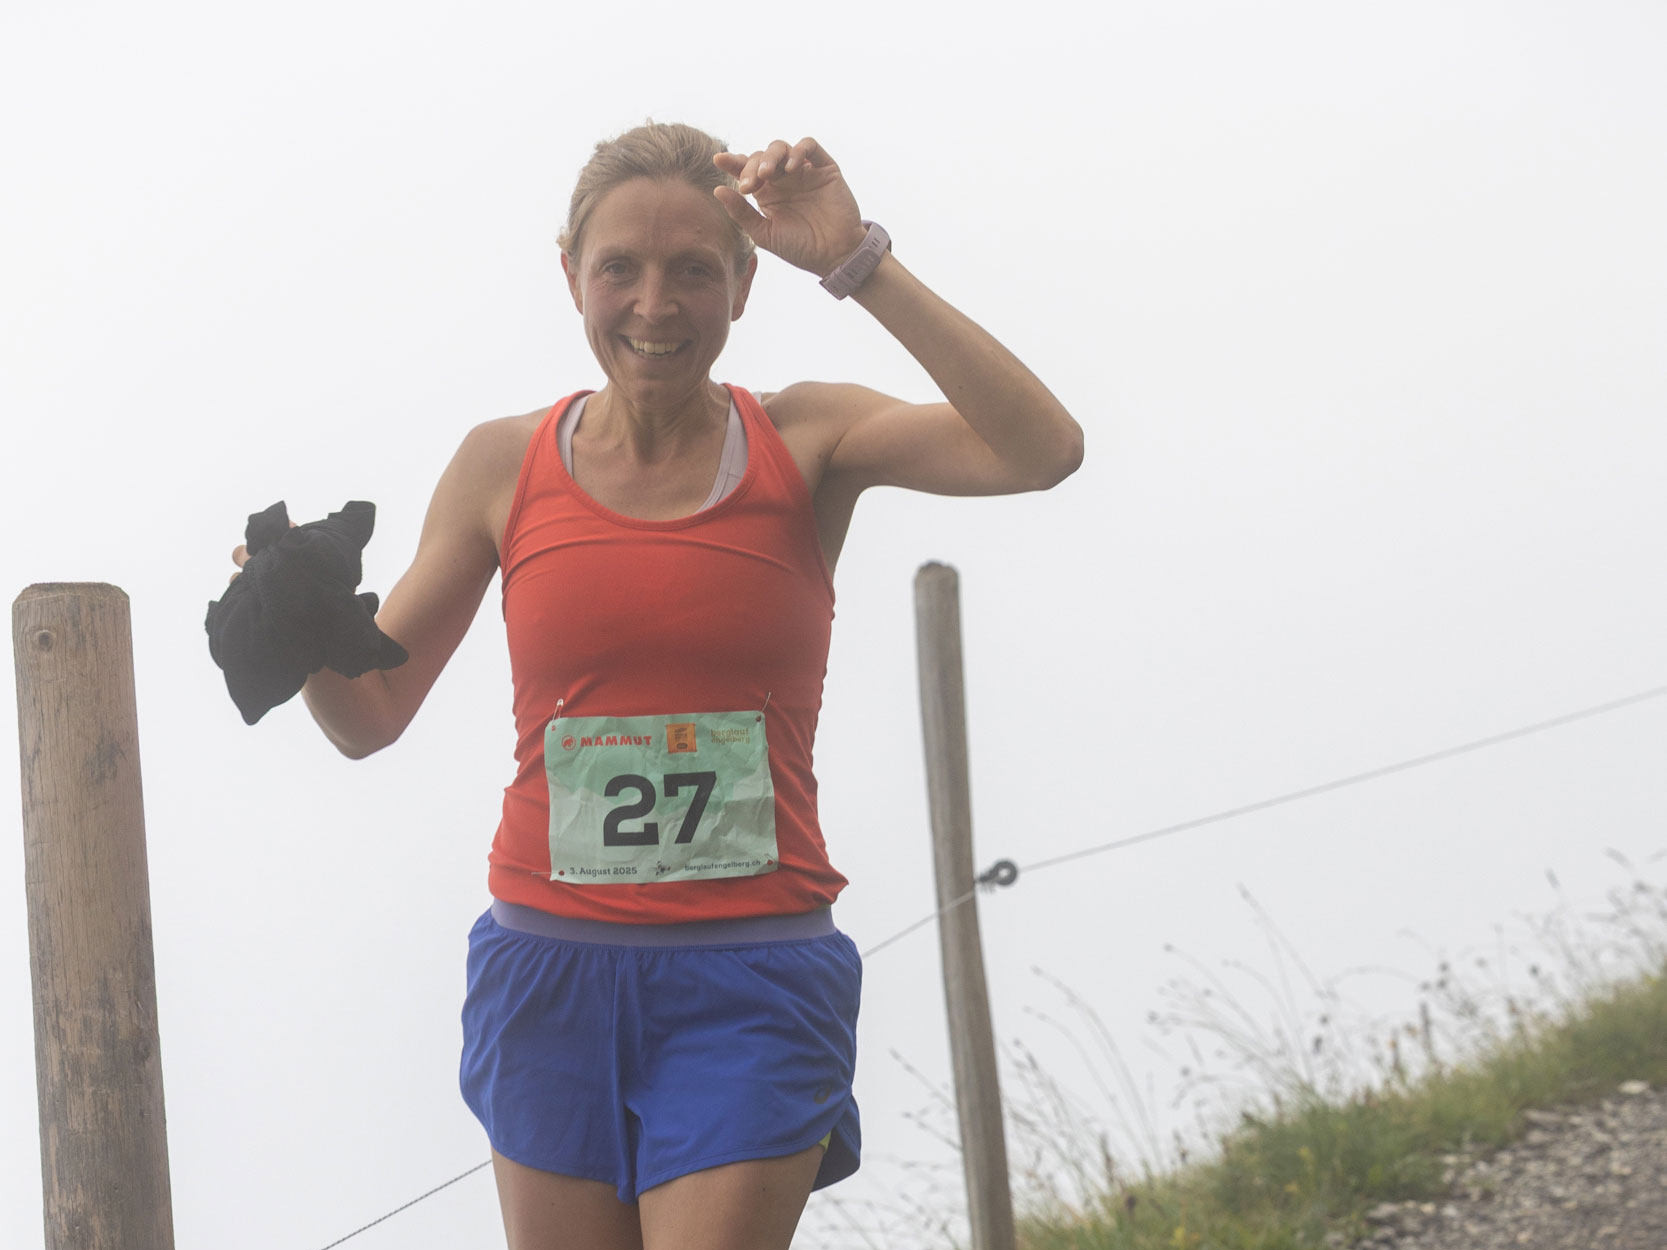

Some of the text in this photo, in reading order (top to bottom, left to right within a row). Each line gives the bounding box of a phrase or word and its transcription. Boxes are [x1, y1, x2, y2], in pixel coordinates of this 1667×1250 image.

[580, 735, 652, 747] MAMMUT
[603, 771, 718, 847] 27
[569, 866, 638, 877] 3. August 2025
[684, 860, 761, 872] berglaufengelberg.ch
